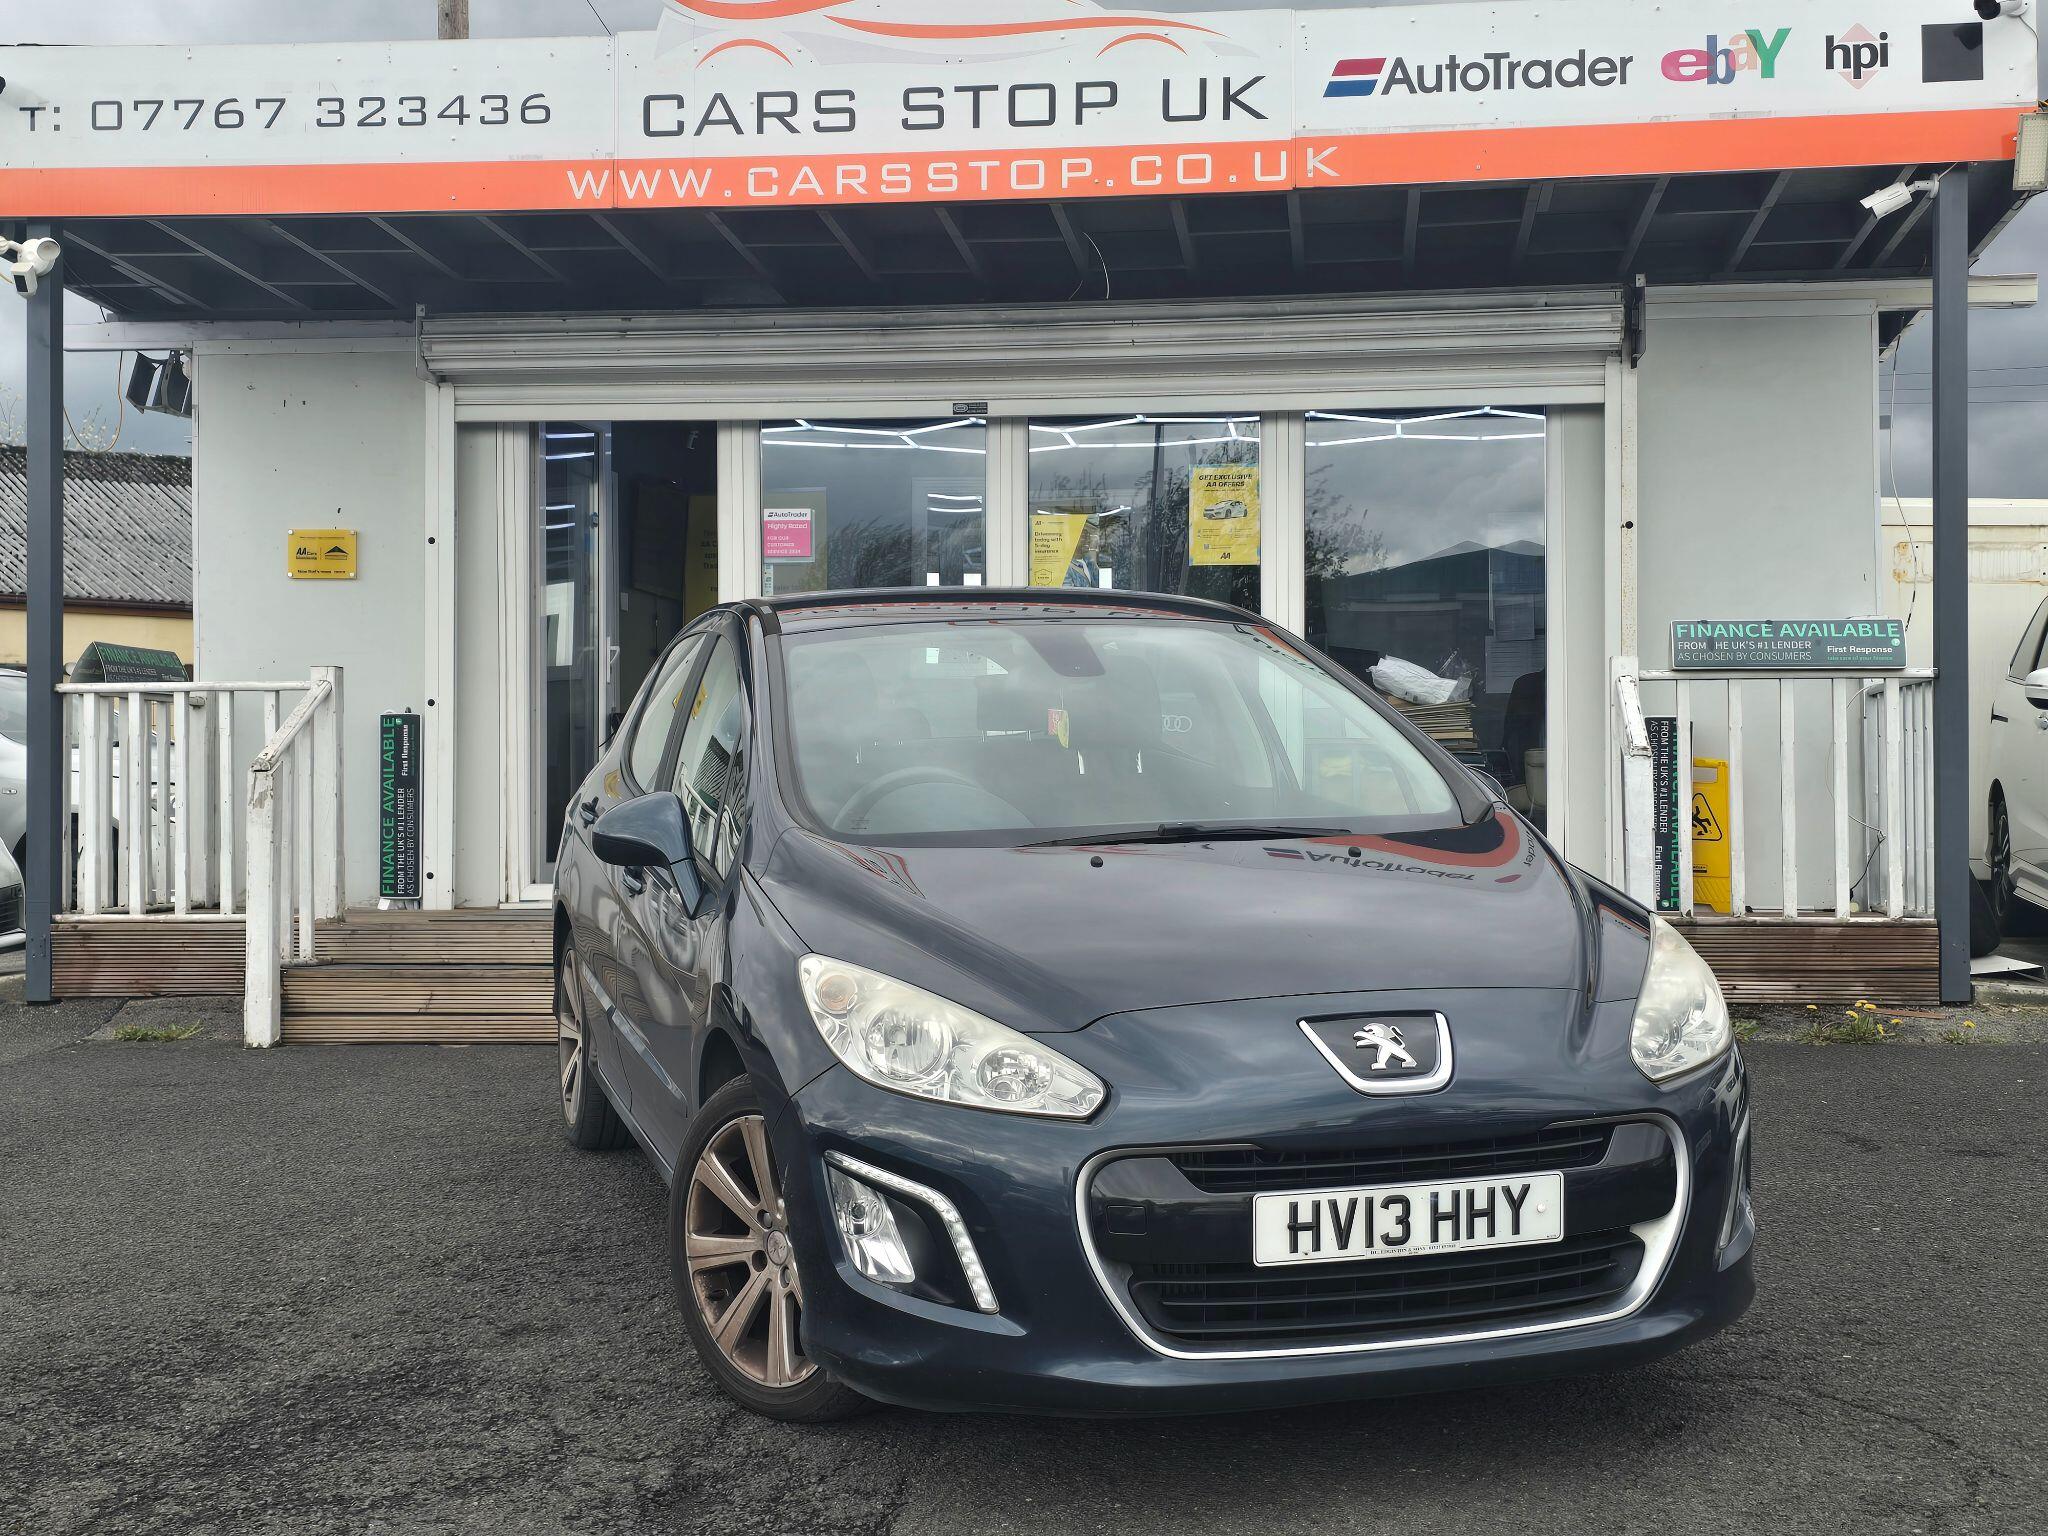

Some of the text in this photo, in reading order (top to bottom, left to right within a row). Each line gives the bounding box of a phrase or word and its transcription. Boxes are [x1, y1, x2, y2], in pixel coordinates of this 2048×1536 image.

[1825, 31, 1889, 80] hpi
[1381, 49, 1634, 96] AutoTrader
[19, 92, 552, 132] T: 07767 323436
[642, 75, 1268, 138] CARS STOP UK
[566, 145, 1341, 200] WWW.CARSSTOP.CO.UK
[1213, 473, 1253, 481] EXCLUSIVE
[1218, 480, 1245, 488] OFFERS
[767, 522, 788, 530] Highly
[1220, 552, 1231, 560] AA
[1676, 622, 1901, 638] FINANCE AVAILABLE
[1677, 651, 1812, 661] AS CHOSEN BY CONSUMERS
[1678, 641, 1707, 650] FROM
[1731, 641, 1756, 650] UK'S
[1757, 641, 1769, 650] #1
[1771, 641, 1812, 650] LENDER
[1849, 646, 1893, 655] Response
[1650, 720, 1659, 731] AS
[1660, 720, 1669, 745] FROM
[401, 724, 410, 776] First Response
[1660, 747, 1668, 764] THE
[1660, 766, 1668, 786] UK'S
[382, 717, 395, 895] FINANCE AVAILABLE
[397, 787, 405, 820] LENDER
[1659, 799, 1668, 833] LENDER
[397, 832, 405, 852] UK'S
[406, 788, 415, 894] AS CHOSEN BY CONSUMERS
[397, 853, 405, 869] THE
[397, 871, 405, 894] FROM
[1287, 1183, 1531, 1254] HV13 HHY
